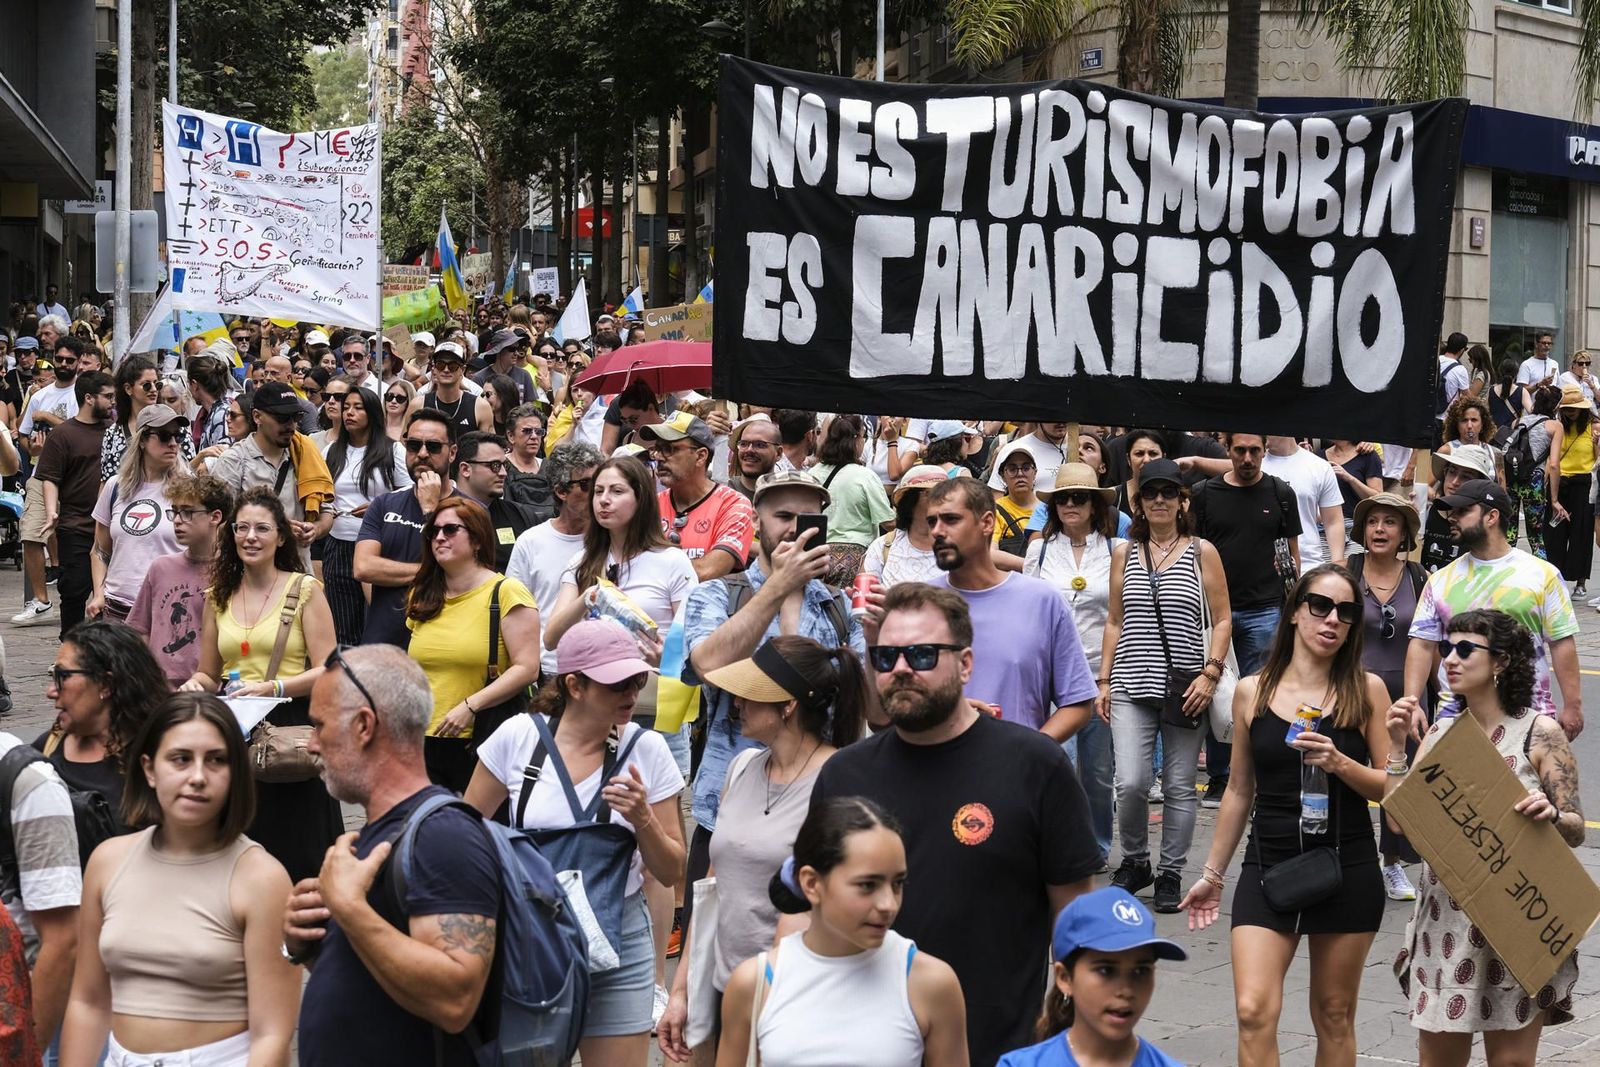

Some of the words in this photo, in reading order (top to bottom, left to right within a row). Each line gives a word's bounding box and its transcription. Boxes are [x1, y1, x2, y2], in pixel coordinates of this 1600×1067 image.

[751, 83, 829, 189] NO
[835, 98, 918, 200] ES
[348, 201, 373, 225] 22
[311, 290, 343, 306] Spring
[743, 232, 824, 345] ES
[1419, 763, 1511, 874] RESPETEN
[1118, 904, 1140, 921] M
[1505, 870, 1548, 921] QUE
[1539, 916, 1574, 957] PA
